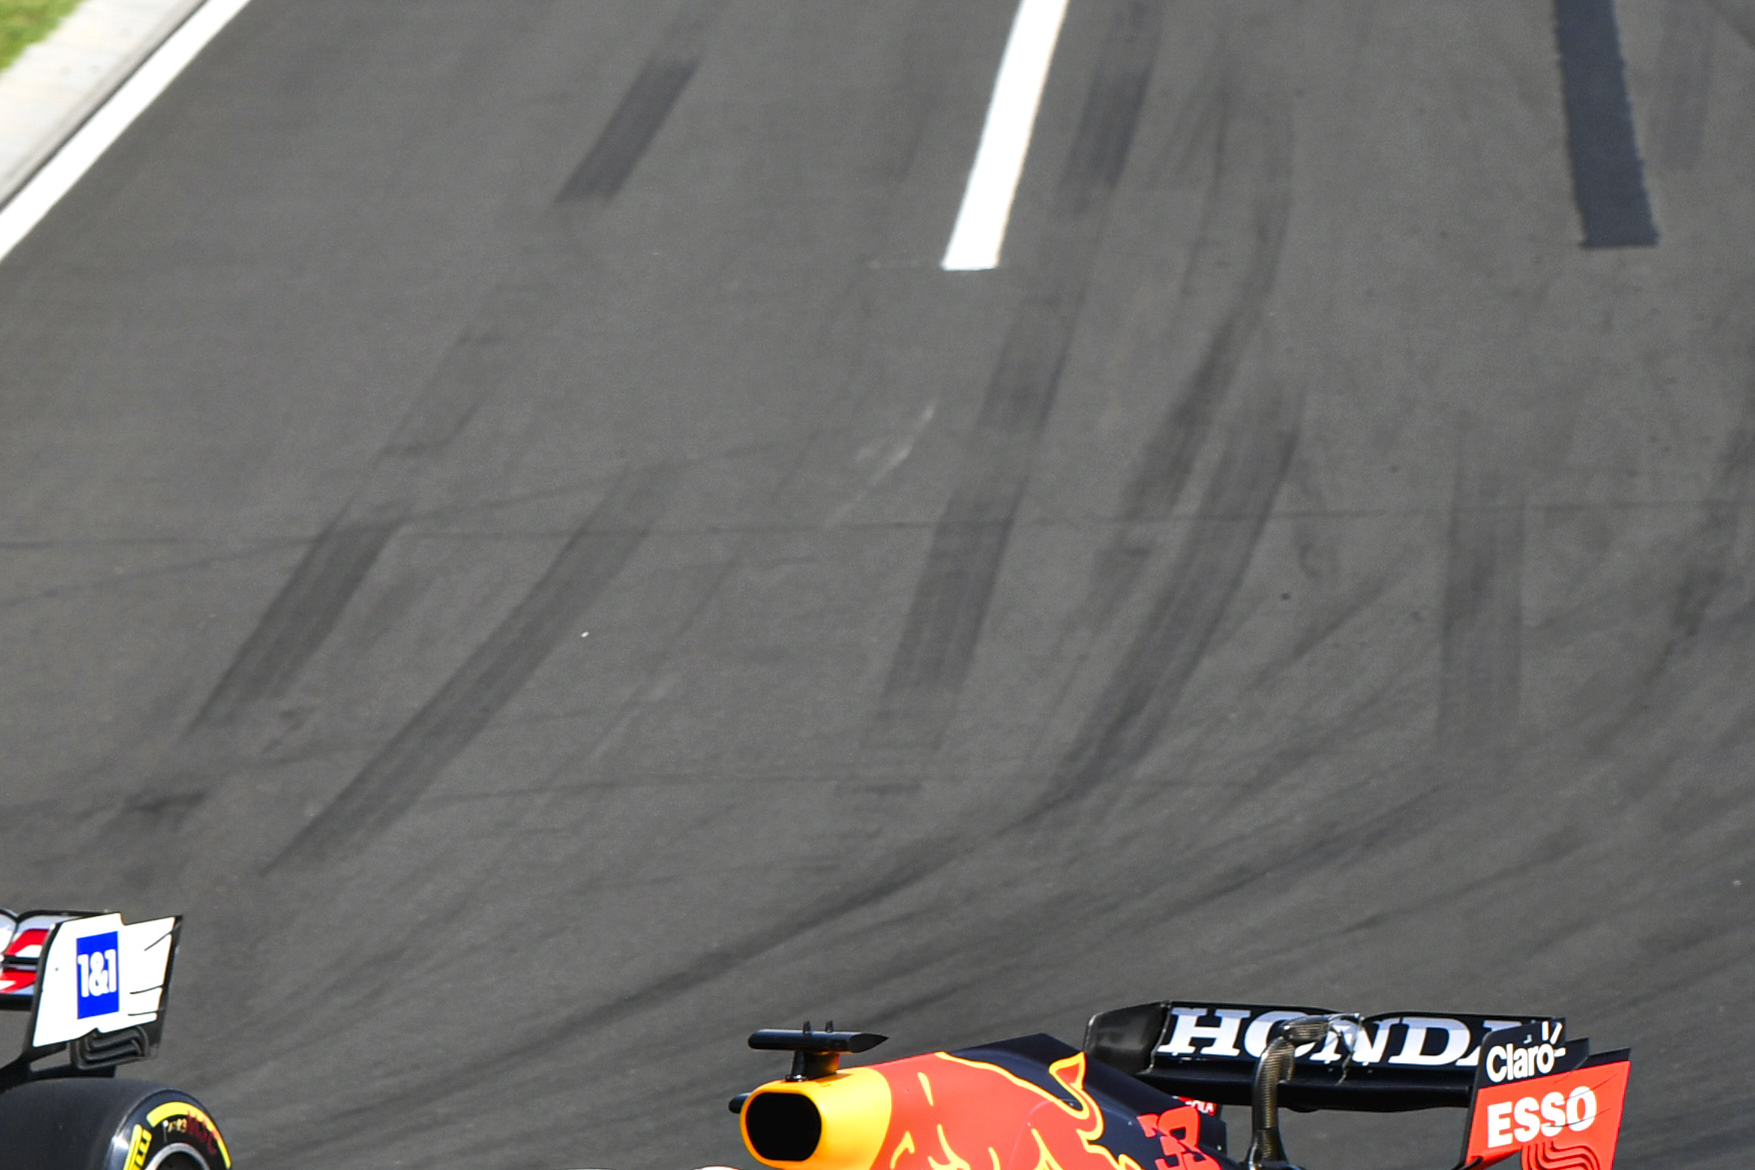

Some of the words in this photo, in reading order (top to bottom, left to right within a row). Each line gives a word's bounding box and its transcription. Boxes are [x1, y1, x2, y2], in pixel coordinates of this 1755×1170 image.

[77, 948, 117, 997] 1&1
[1486, 1036, 1555, 1083] Claro
[1487, 1084, 1597, 1148] ESSO
